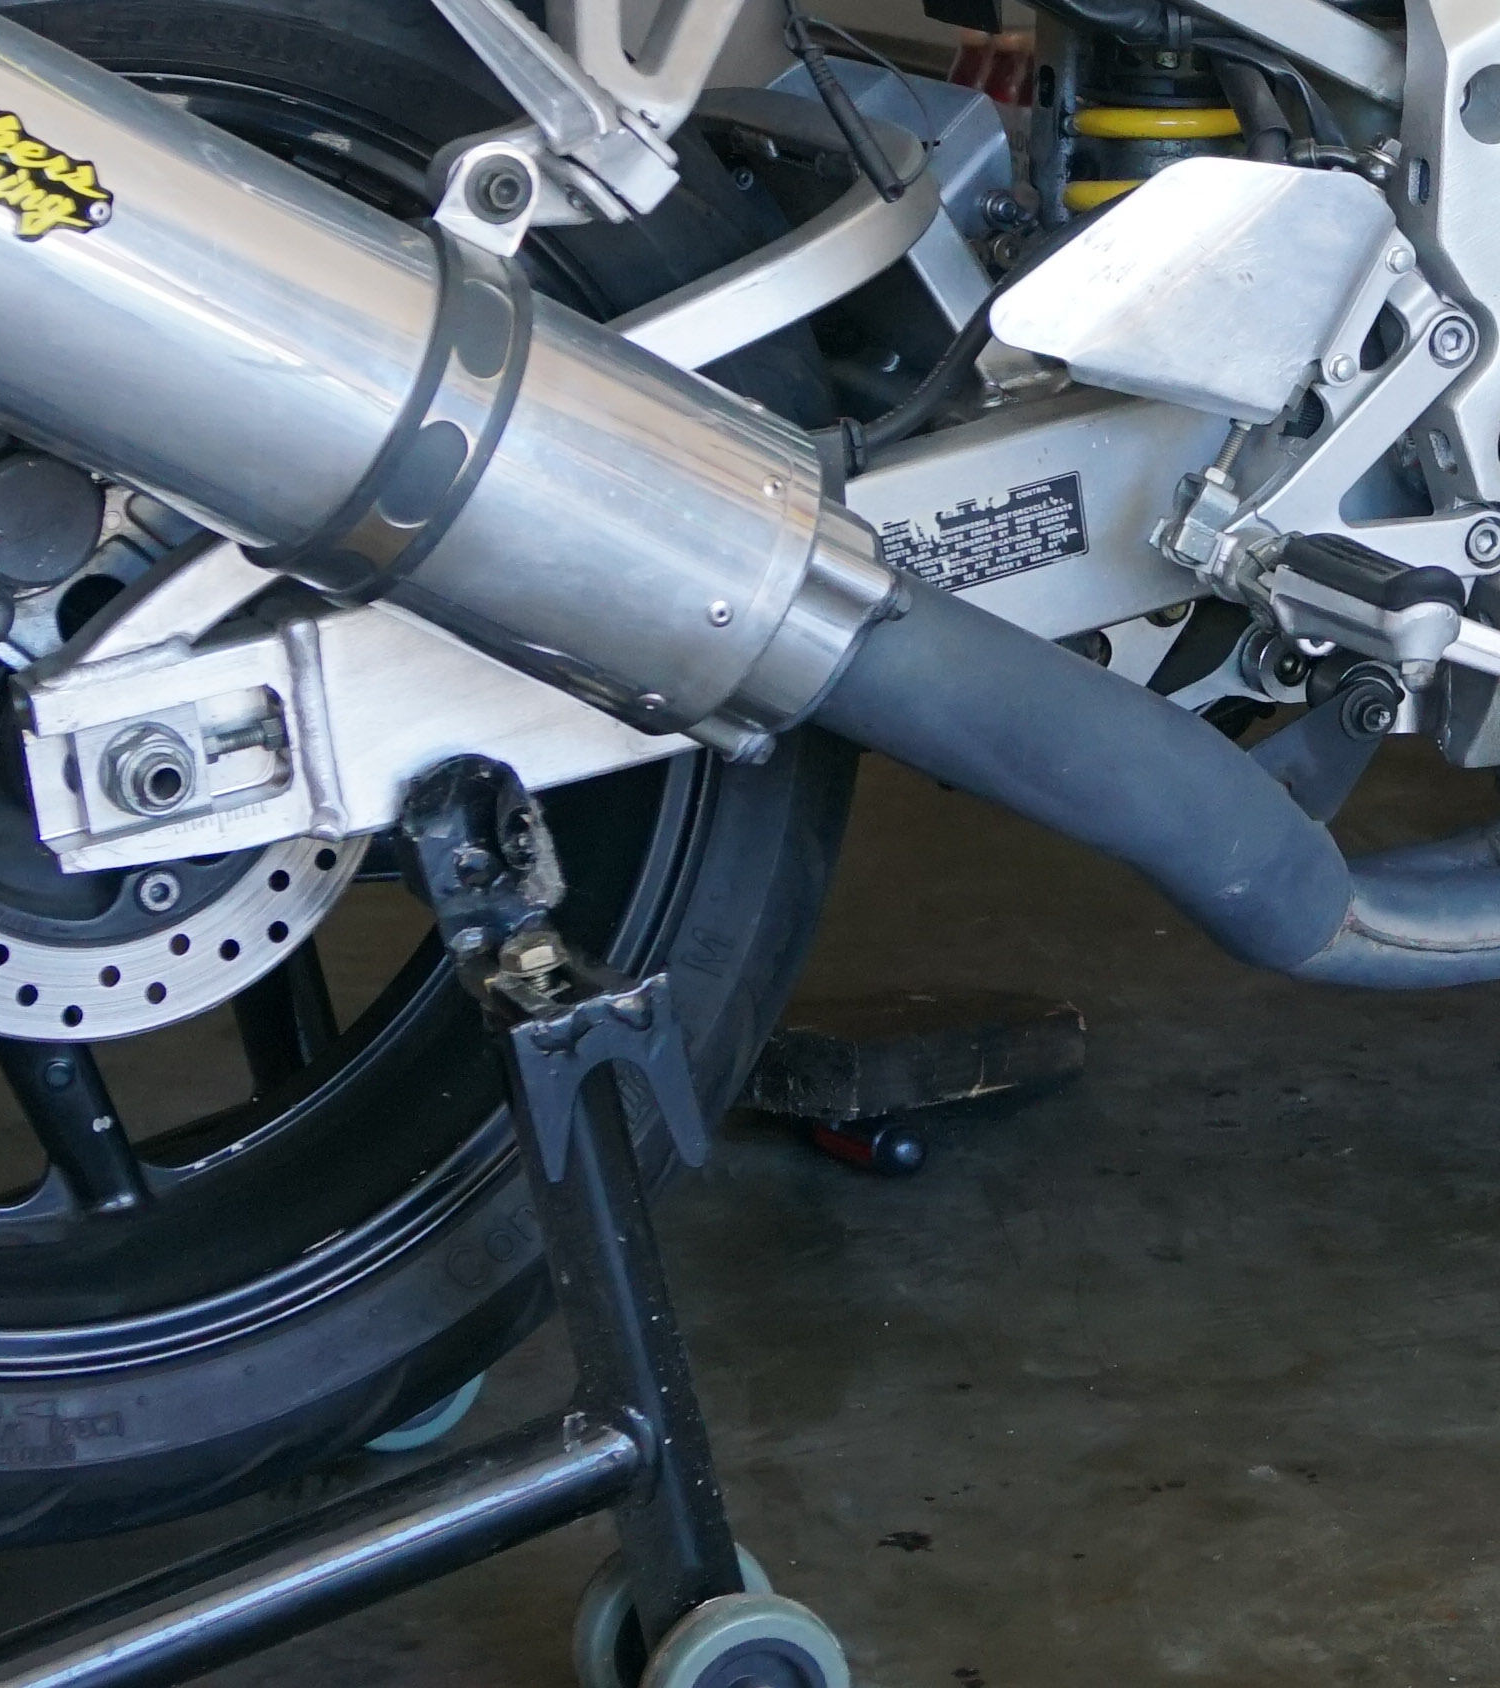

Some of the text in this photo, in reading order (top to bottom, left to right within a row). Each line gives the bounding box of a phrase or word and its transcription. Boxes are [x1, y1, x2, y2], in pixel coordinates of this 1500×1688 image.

[1014, 483, 1051, 499] CONTROL
[1015, 523, 1031, 532] THE
[1035, 512, 1069, 527] FEDERAL
[942, 549, 994, 570] OTORCYCLE
[998, 546, 1010, 554] TO
[1014, 536, 1043, 550] EXCEED
